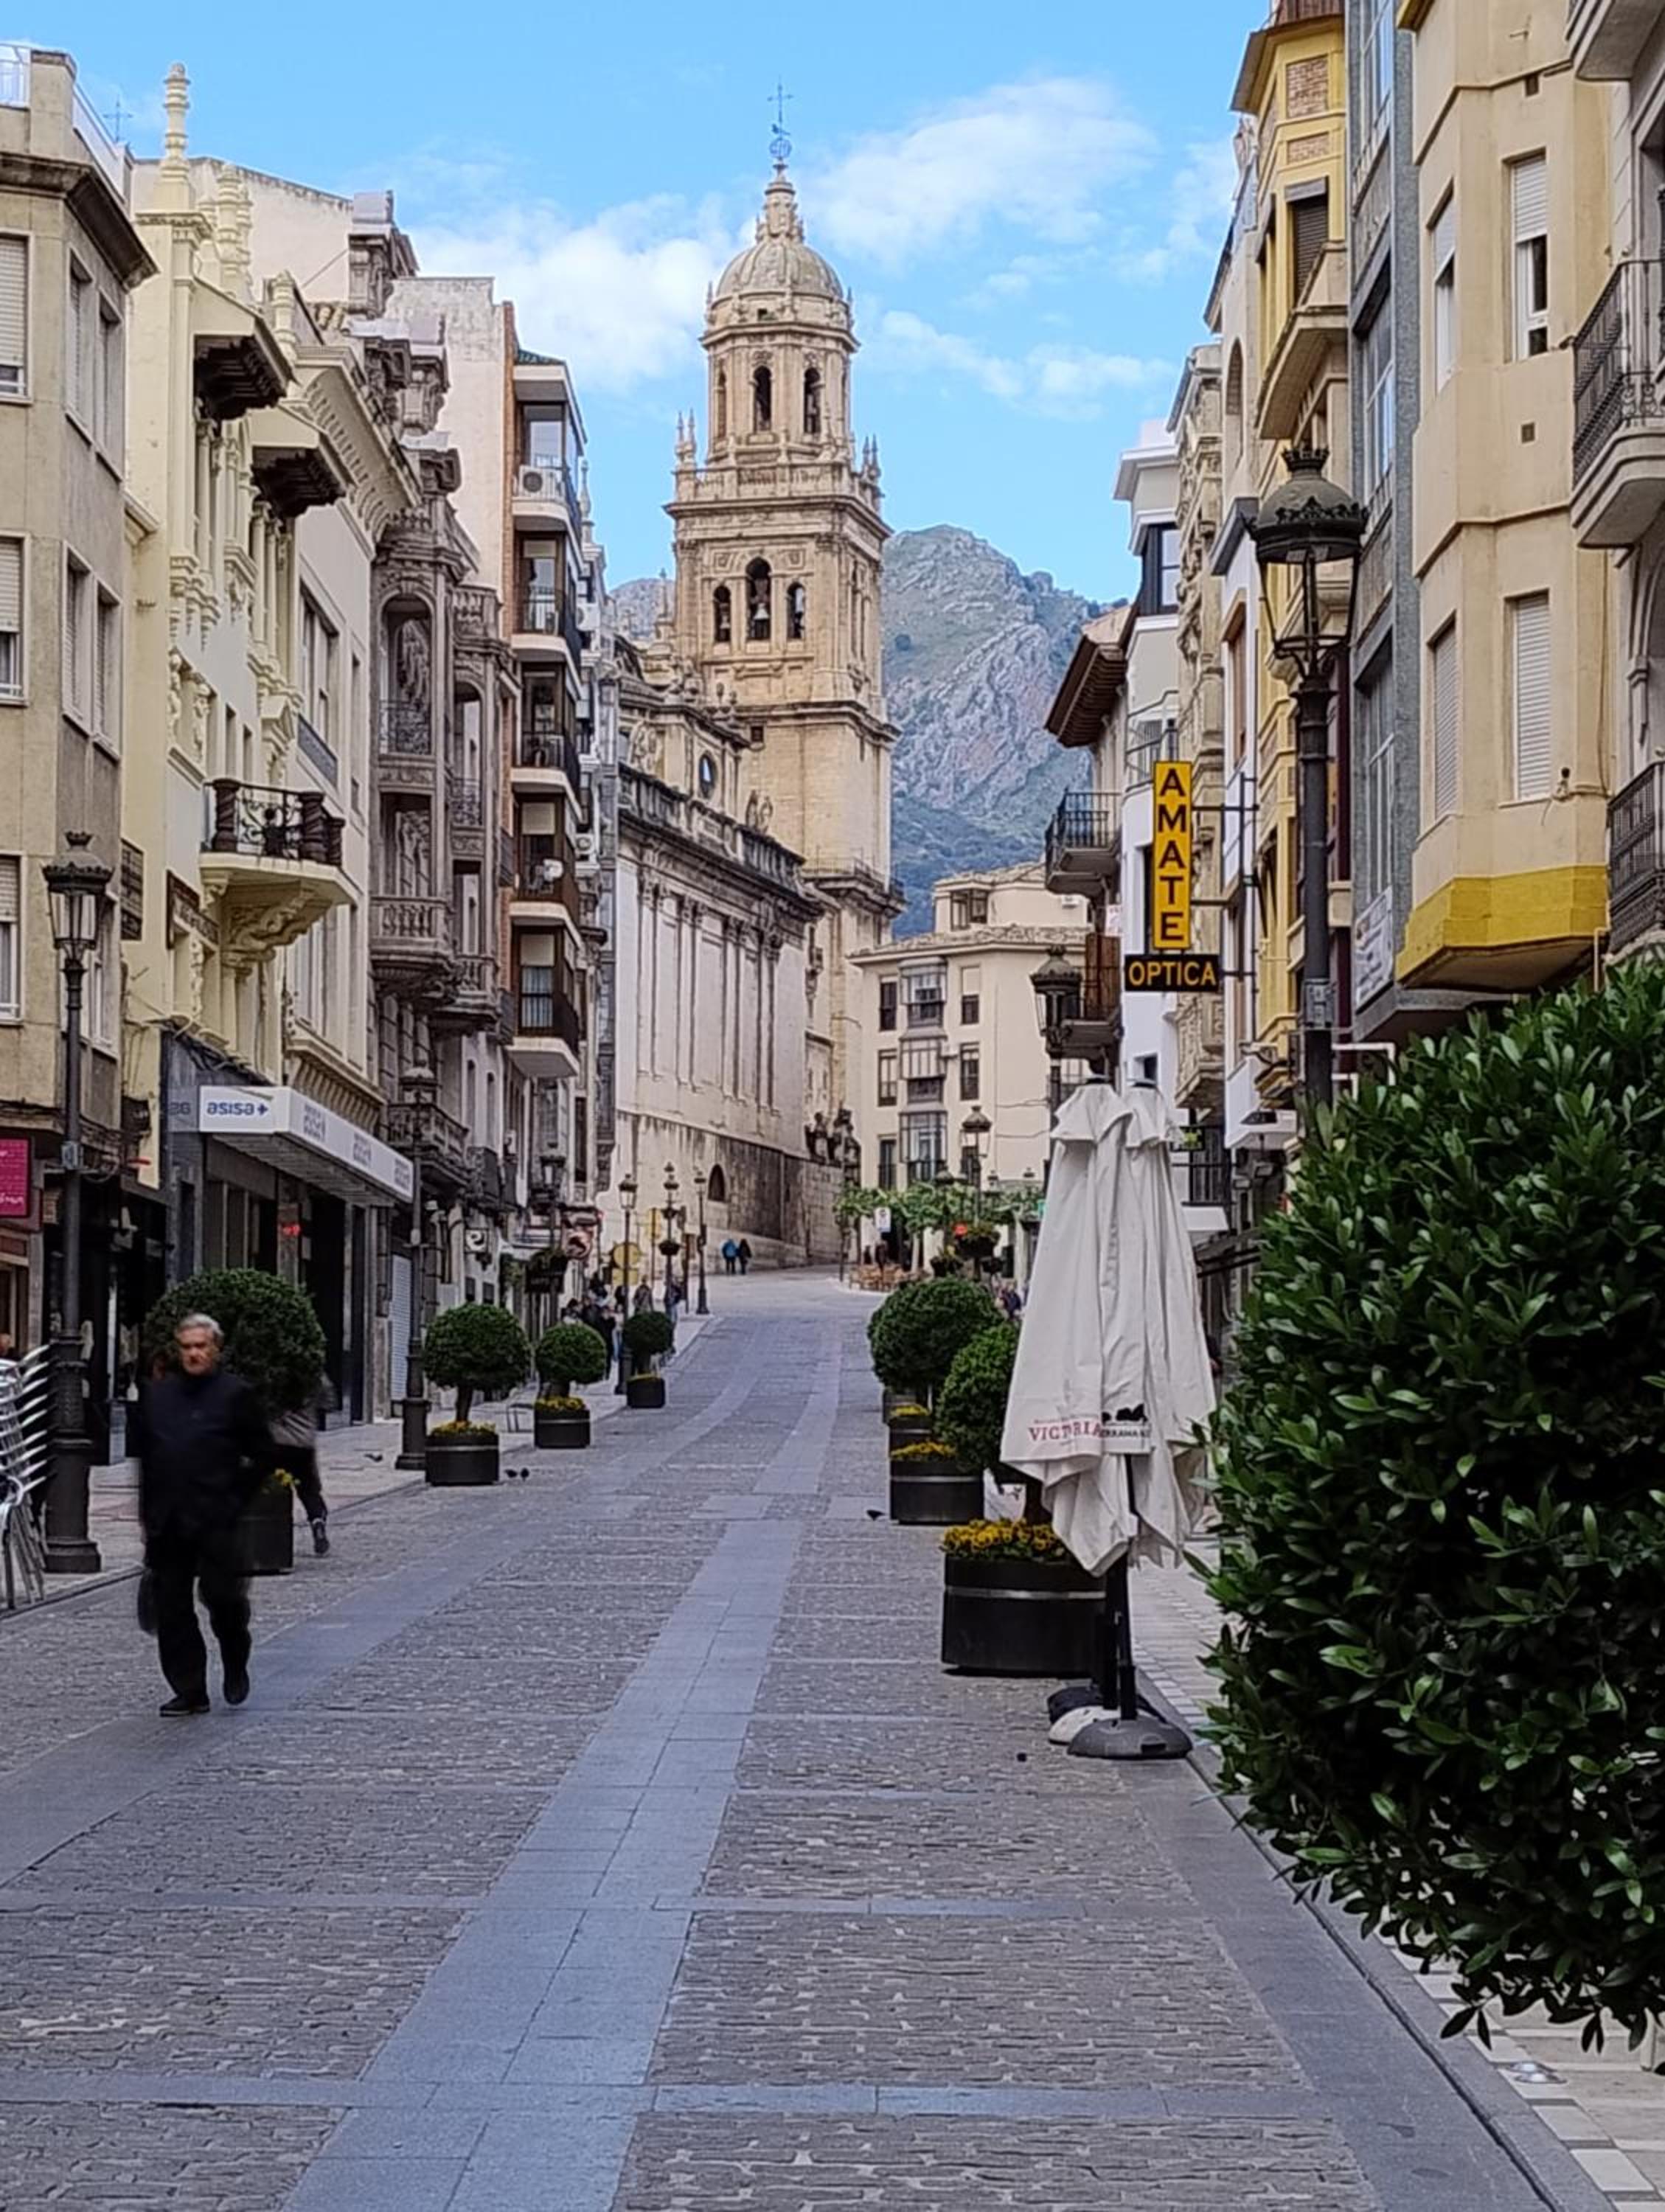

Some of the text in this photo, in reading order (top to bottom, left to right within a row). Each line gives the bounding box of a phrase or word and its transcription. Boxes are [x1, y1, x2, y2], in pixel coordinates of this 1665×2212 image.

[1157, 768, 1186, 942] AMATE
[1128, 961, 1217, 987] OPTICA
[207, 1102, 254, 1116] asisa
